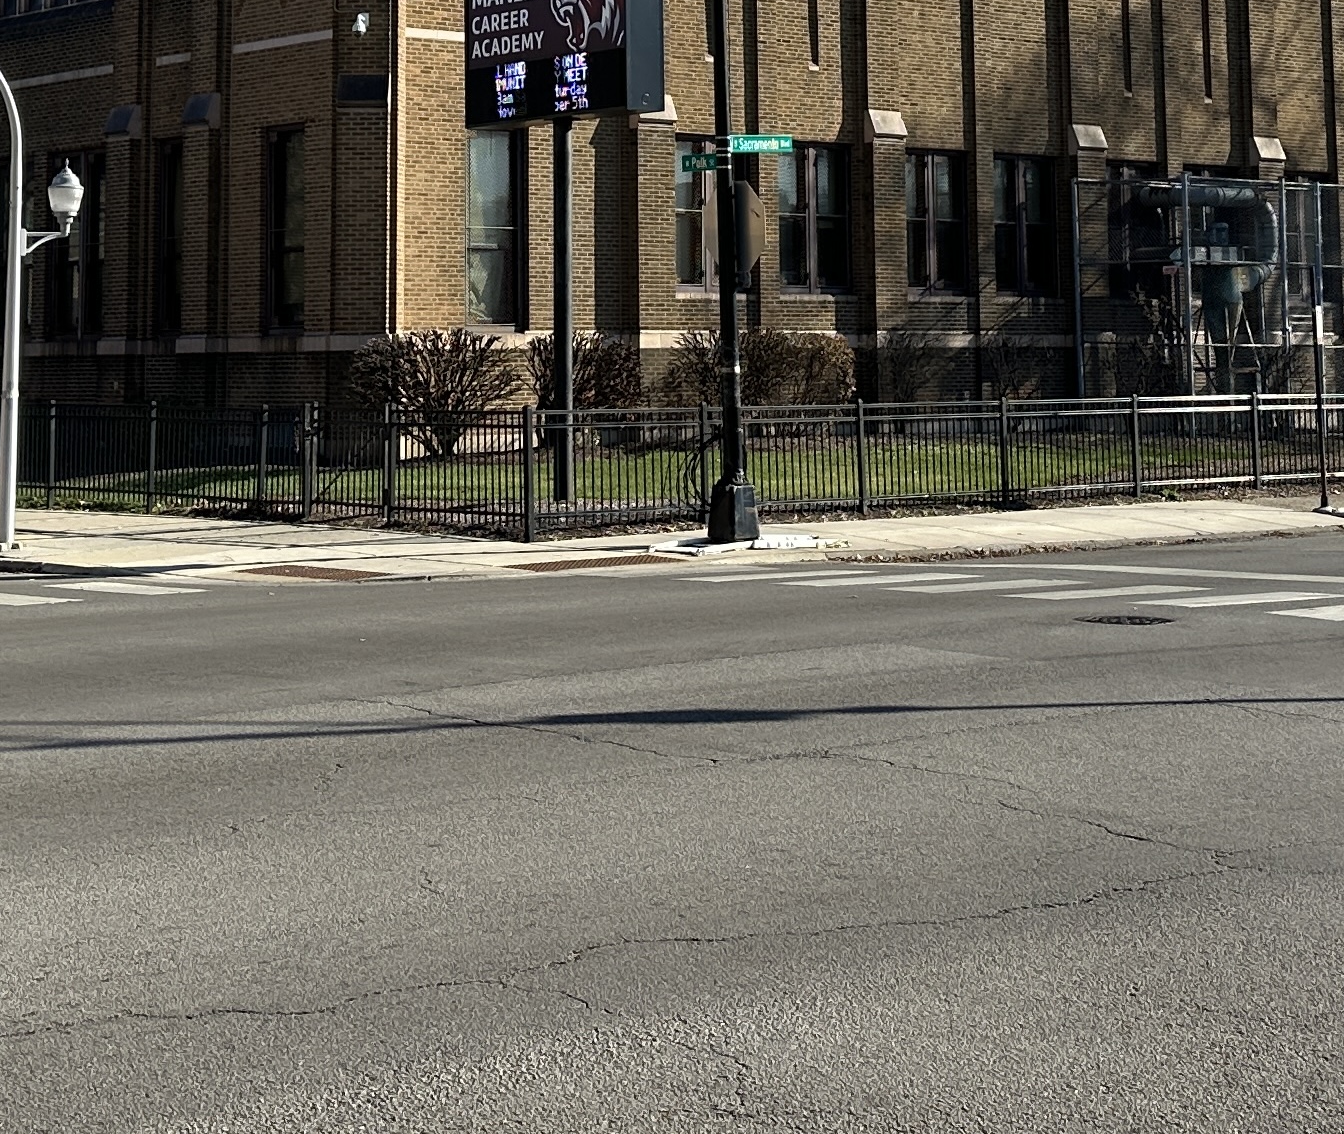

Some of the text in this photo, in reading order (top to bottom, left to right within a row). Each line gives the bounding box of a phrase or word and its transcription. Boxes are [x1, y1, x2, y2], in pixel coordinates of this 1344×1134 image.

[472, 9, 529, 34] CAREER
[471, 30, 545, 59] ACADEMY
[572, 95, 588, 110] 5th
[692, 156, 707, 168] Polk
